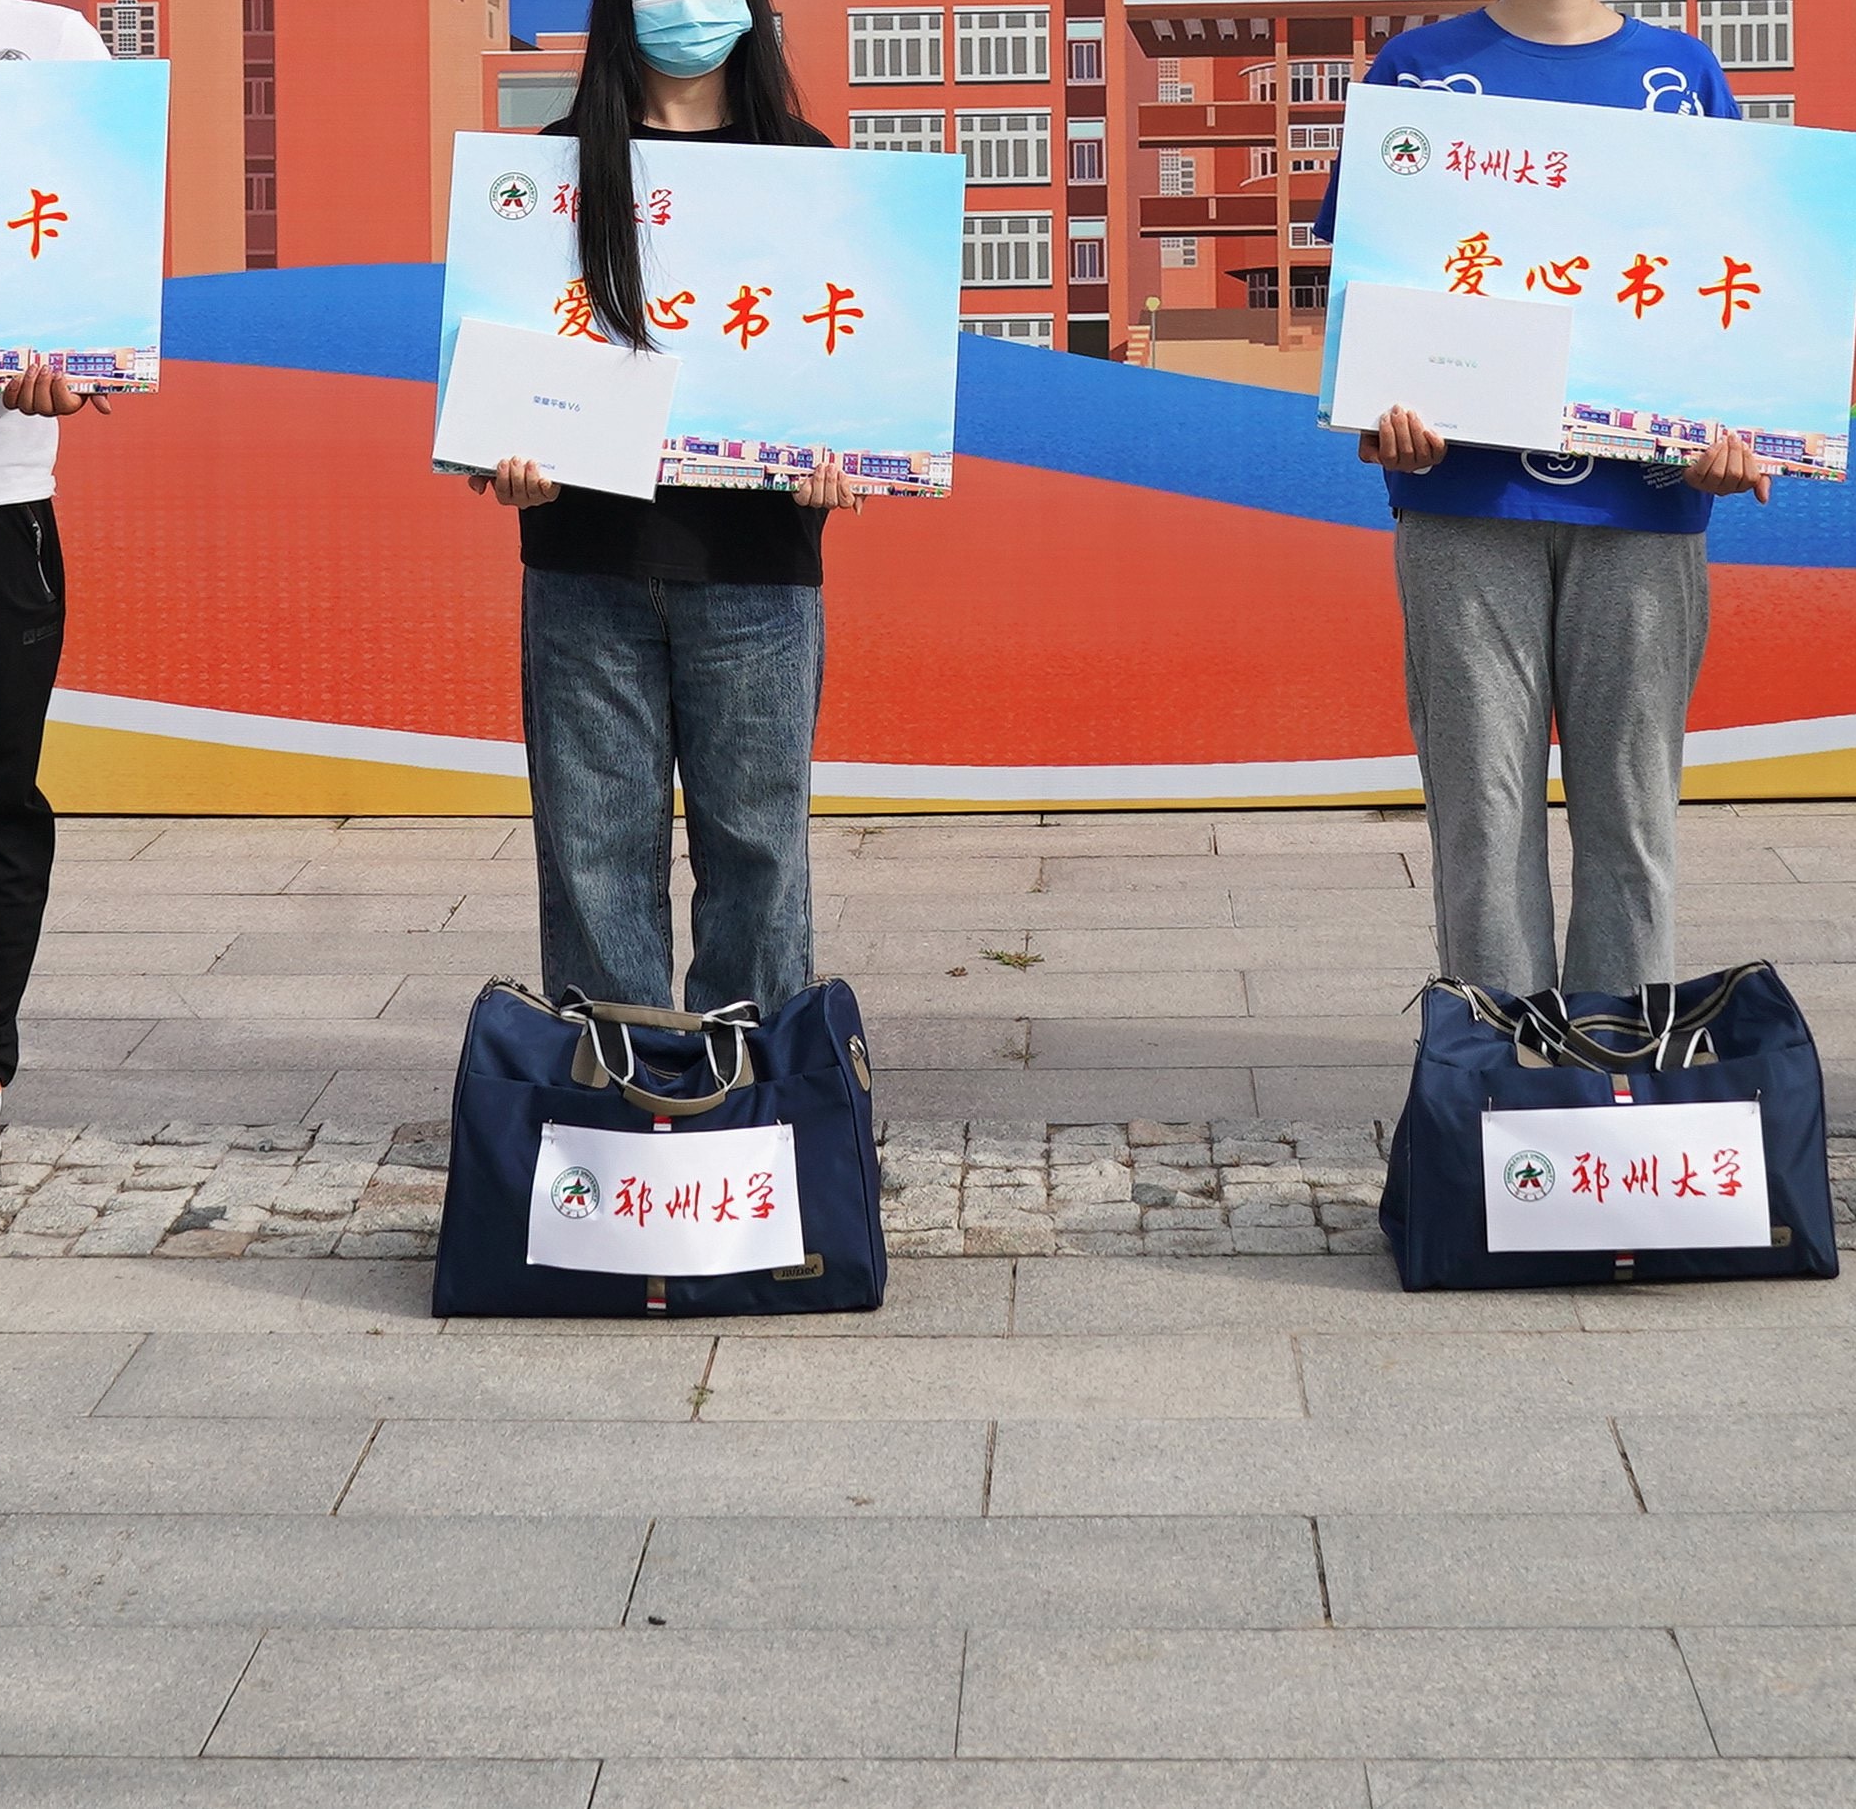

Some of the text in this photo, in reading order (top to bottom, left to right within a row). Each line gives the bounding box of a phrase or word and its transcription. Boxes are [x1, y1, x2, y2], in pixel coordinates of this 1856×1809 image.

[1445, 140, 1569, 189] 郑州大学
[552, 182, 673, 226] 郑学
[1444, 230, 1761, 330] 爱心书卡
[553, 277, 864, 356] 爱心书卡
[613, 1171, 775, 1228] 郑州大学
[1571, 1148, 1742, 1204] 郑州大学
